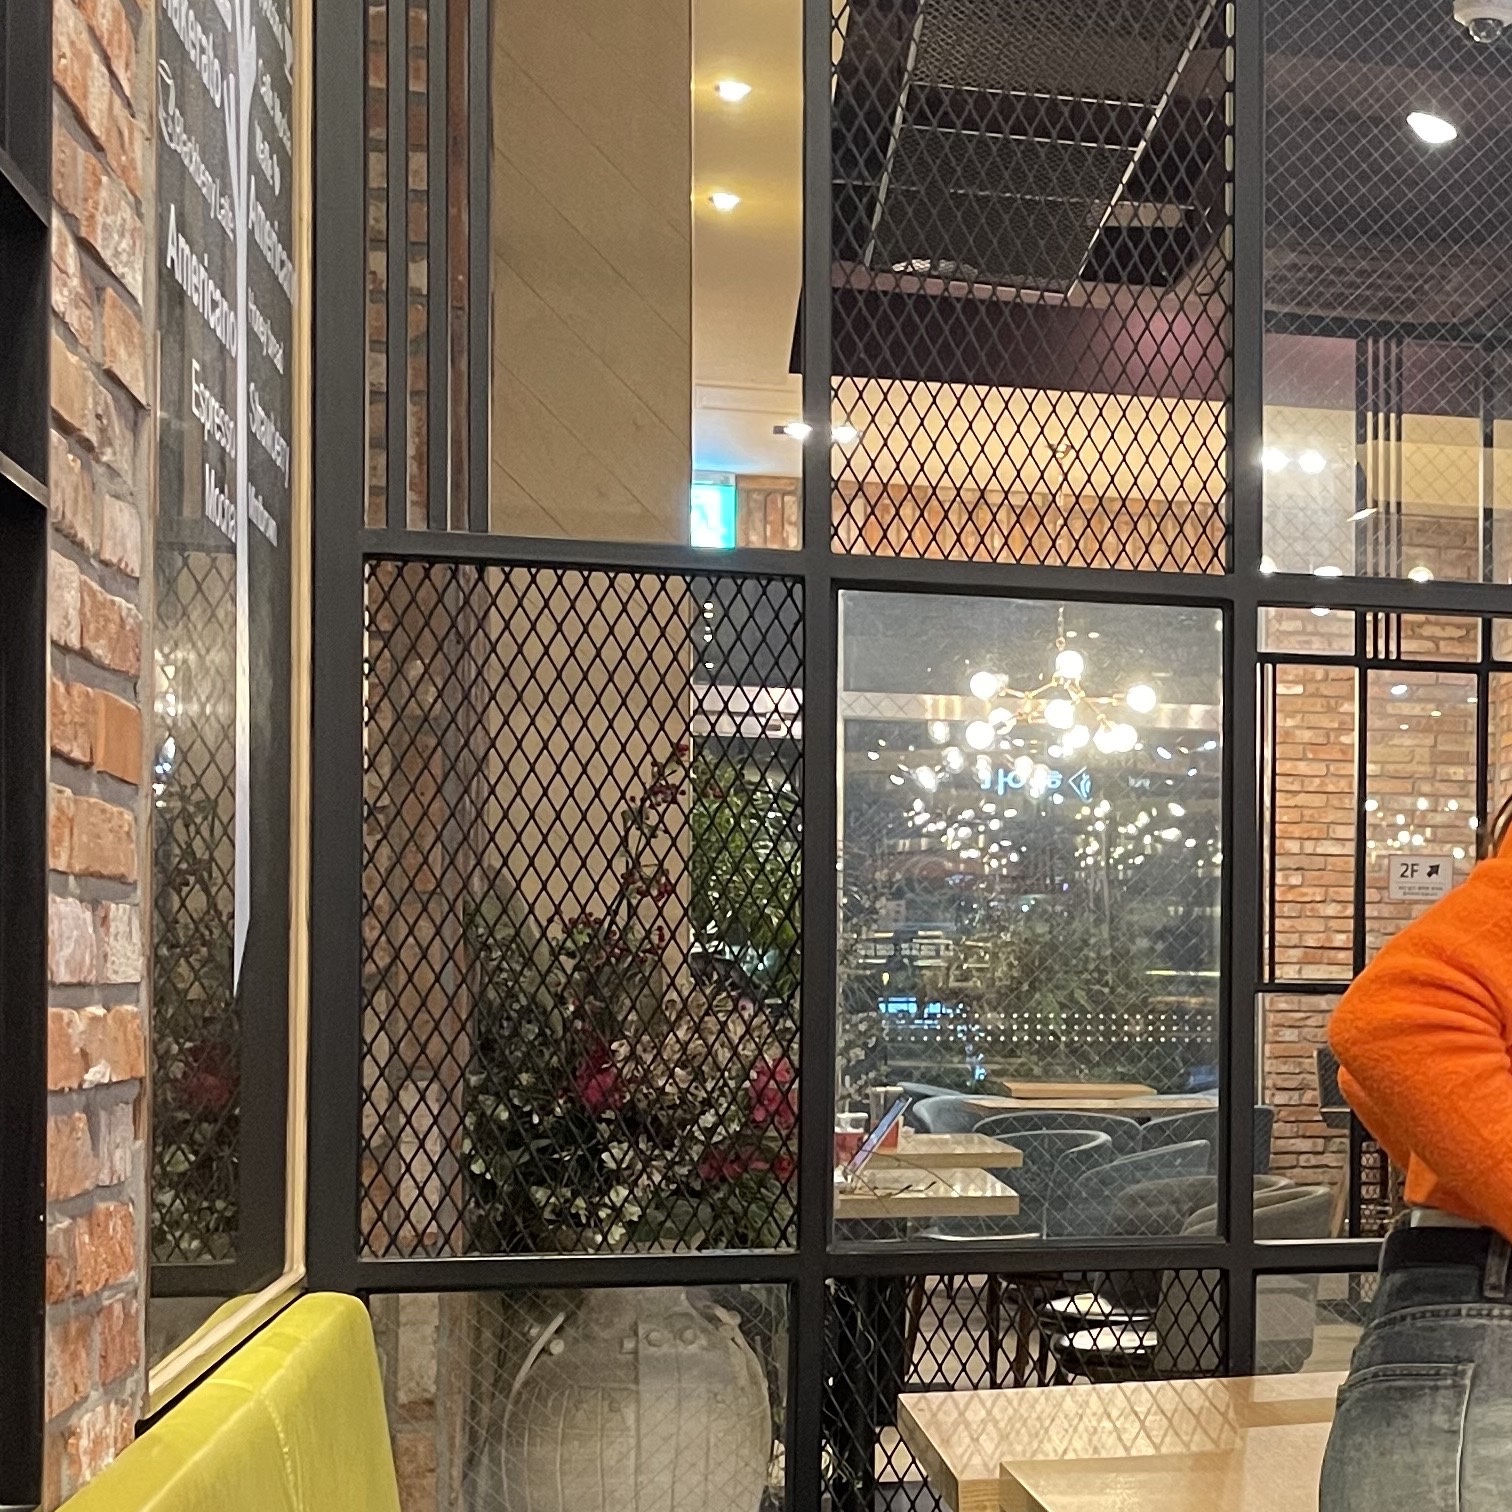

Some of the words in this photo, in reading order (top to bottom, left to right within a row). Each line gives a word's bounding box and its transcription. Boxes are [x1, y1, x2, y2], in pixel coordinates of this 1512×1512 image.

[166, 203, 236, 358] Americano
[191, 358, 236, 459] Espresso
[205, 463, 236, 543] Mocha
[1400, 863, 1419, 878] 2F
